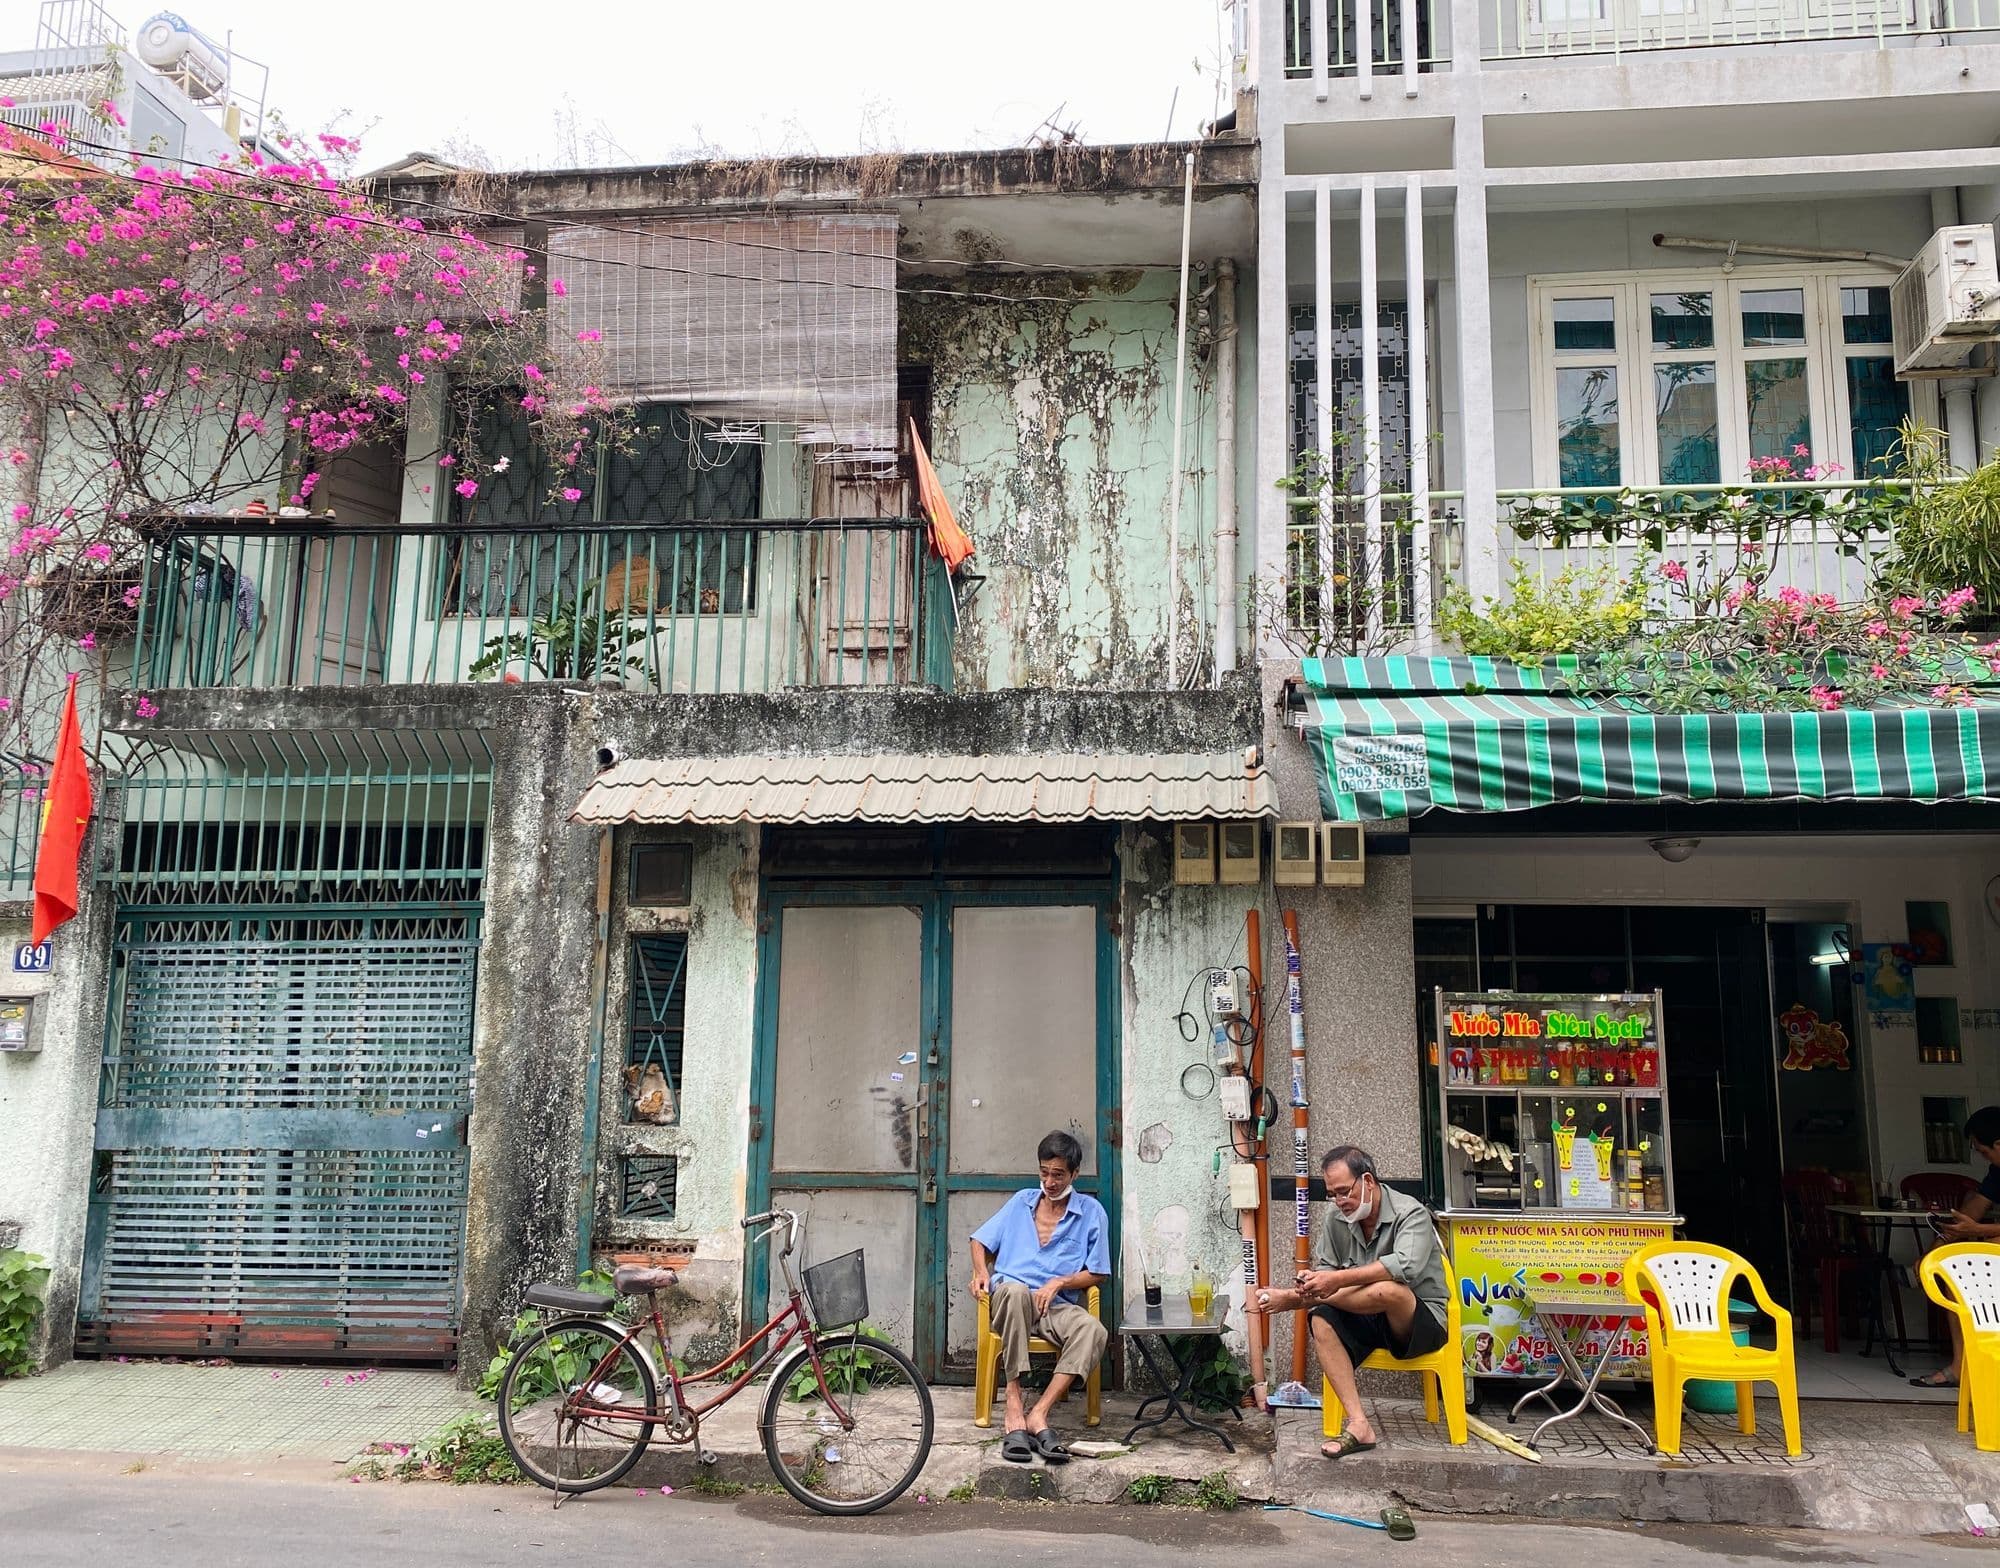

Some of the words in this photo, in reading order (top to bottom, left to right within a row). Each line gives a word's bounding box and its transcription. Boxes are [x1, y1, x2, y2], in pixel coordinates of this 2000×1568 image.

[20, 945, 46, 968] 69
[1451, 1012, 1500, 1037] Nước
[1503, 1012, 1541, 1037] Mía
[1547, 1011, 1591, 1038] Siêu
[1595, 1012, 1644, 1046] Sạch
